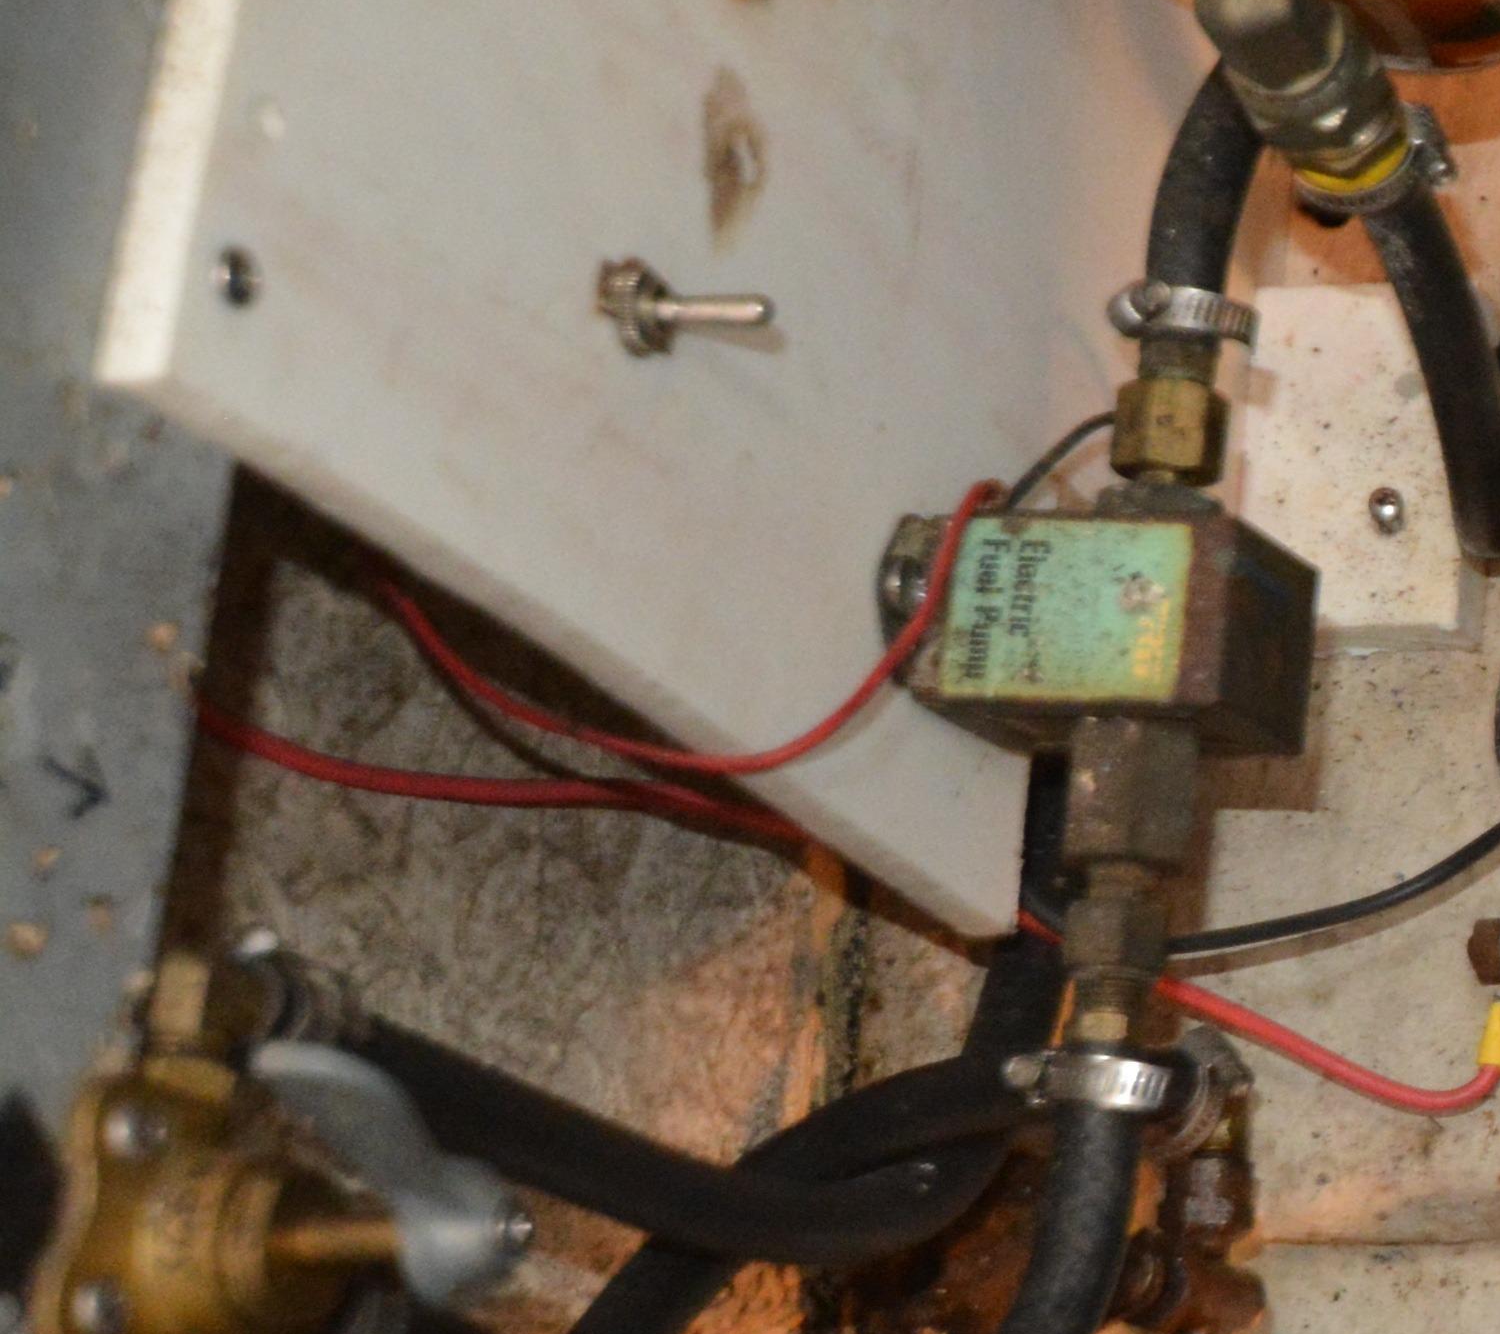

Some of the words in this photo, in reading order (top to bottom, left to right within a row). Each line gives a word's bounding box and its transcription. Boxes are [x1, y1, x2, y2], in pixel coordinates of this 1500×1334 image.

[976, 537, 1011, 594] Fuel
[1010, 539, 1052, 638] Electric
[958, 606, 1001, 680] Pump
